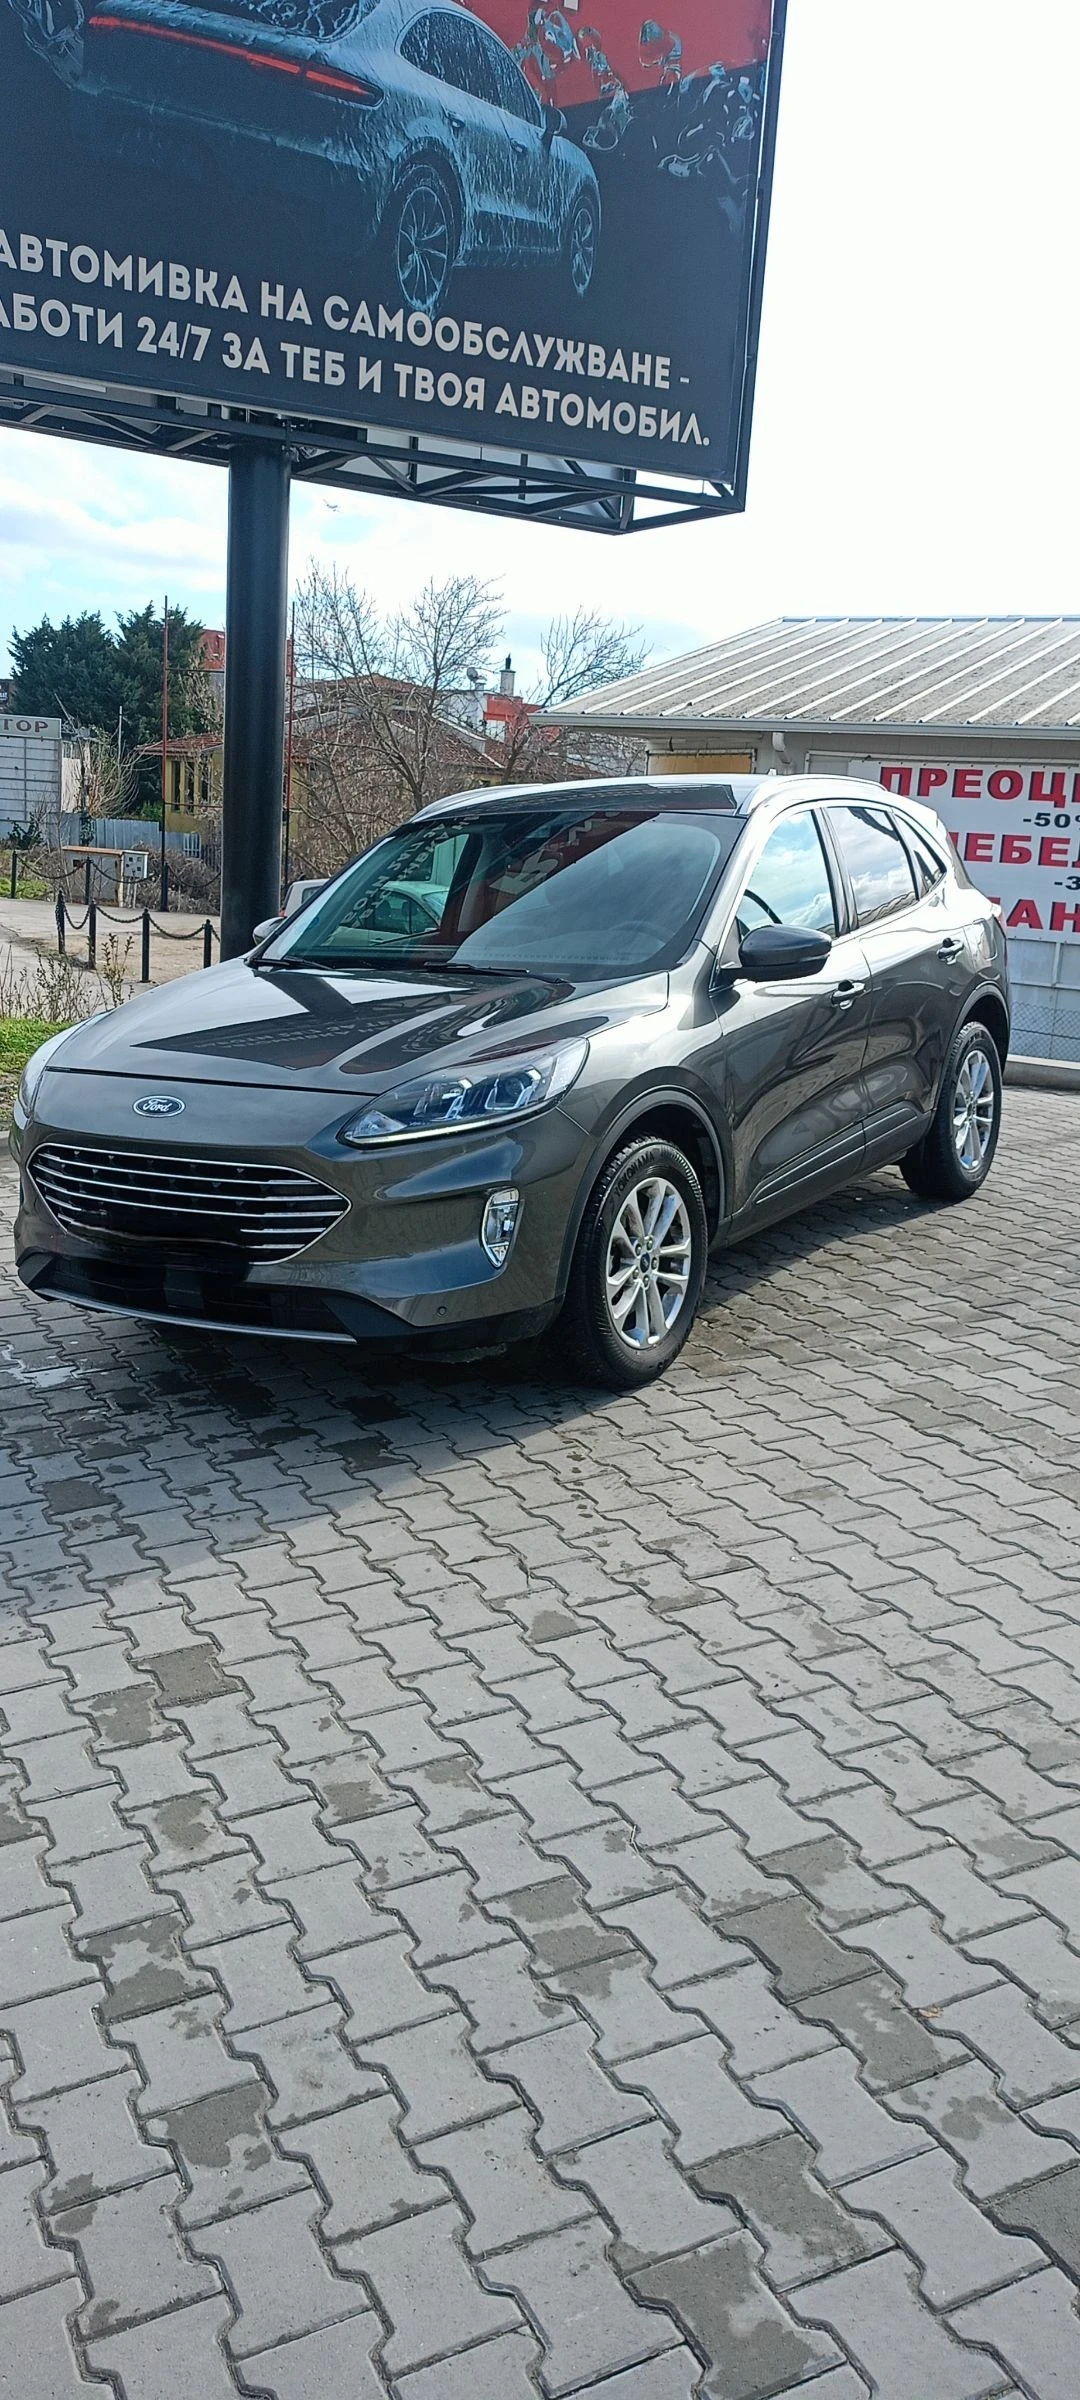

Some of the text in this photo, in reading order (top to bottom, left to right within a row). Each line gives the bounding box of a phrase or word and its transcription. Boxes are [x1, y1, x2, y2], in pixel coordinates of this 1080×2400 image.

[0, 229, 249, 314] АВТОМИВКА
[260, 281, 313, 326] НА
[323, 295, 671, 390] САМООБСЛУЖВАНЕ
[136, 316, 211, 362] 24/7
[222, 332, 271, 375] ЗА
[280, 342, 346, 387] ТЕБ
[358, 356, 382, 394] И
[394, 362, 485, 411] ТВОЯ
[495, 382, 711, 447] АВТОМОБИЛ.
[880, 766, 1080, 808] ПРЕОЦ
[1022, 812, 1080, 829] -50
[987, 896, 1080, 933] АН
[142, 1098, 173, 1112] Ford
